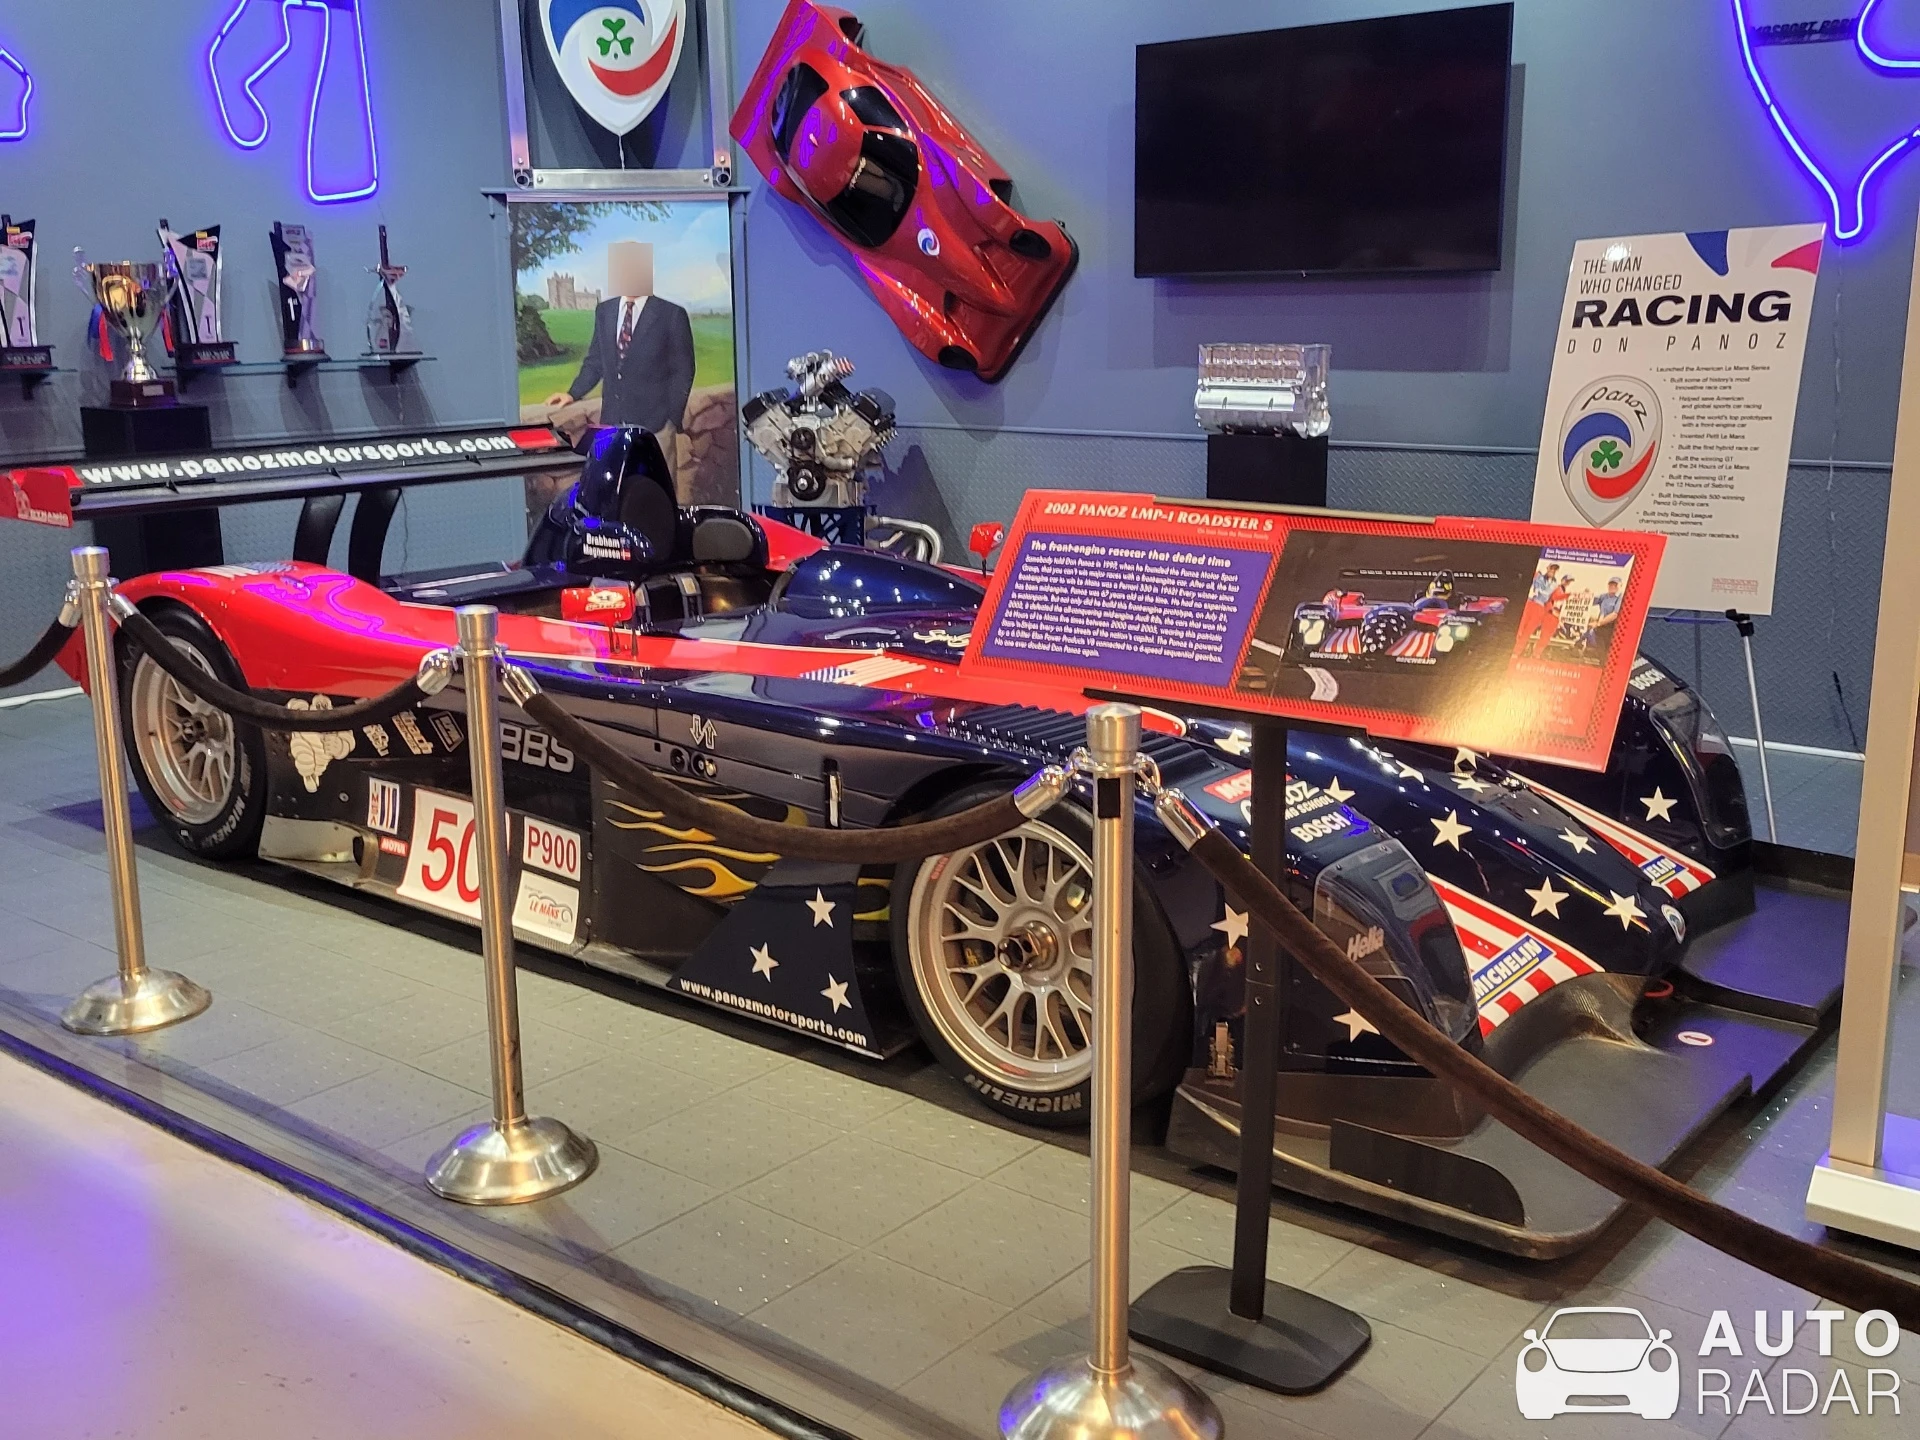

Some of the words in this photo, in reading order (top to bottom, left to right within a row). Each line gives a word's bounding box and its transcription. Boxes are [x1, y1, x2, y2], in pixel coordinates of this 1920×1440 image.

[1583, 259, 1606, 275] THE
[1611, 256, 1642, 273] MAN
[1580, 278, 1610, 294] WHO
[1615, 274, 1682, 292] CHANGED
[1571, 290, 1792, 329] RACING
[1567, 337, 1628, 354] DON
[1666, 332, 1787, 351] PANOZ
[82, 432, 516, 484] www.panozmotorsports.com
[1044, 502, 1076, 515] 2002
[1079, 504, 1127, 519] PANOZ
[1177, 512, 1260, 531] ROADSTER
[1263, 519, 1273, 531] S
[583, 544, 620, 559] Magnussen
[586, 533, 620, 548] Brabham
[1031, 540, 1046, 551] The
[1049, 541, 1106, 556] front-engine
[1108, 548, 1146, 559] racecar
[1148, 549, 1170, 561] that
[1172, 552, 1206, 565] defied
[1207, 555, 1231, 568] time
[500, 723, 575, 773] BBS
[1297, 794, 1334, 814] SCHOOL
[1291, 811, 1351, 843] BOSCH
[527, 825, 577, 873] P900
[1347, 925, 1384, 961] Hella
[1473, 938, 1543, 998] MICHELIN
[680, 978, 867, 1047] www.panozmotorsports.com
[964, 1073, 1082, 1112] MICHELIN
